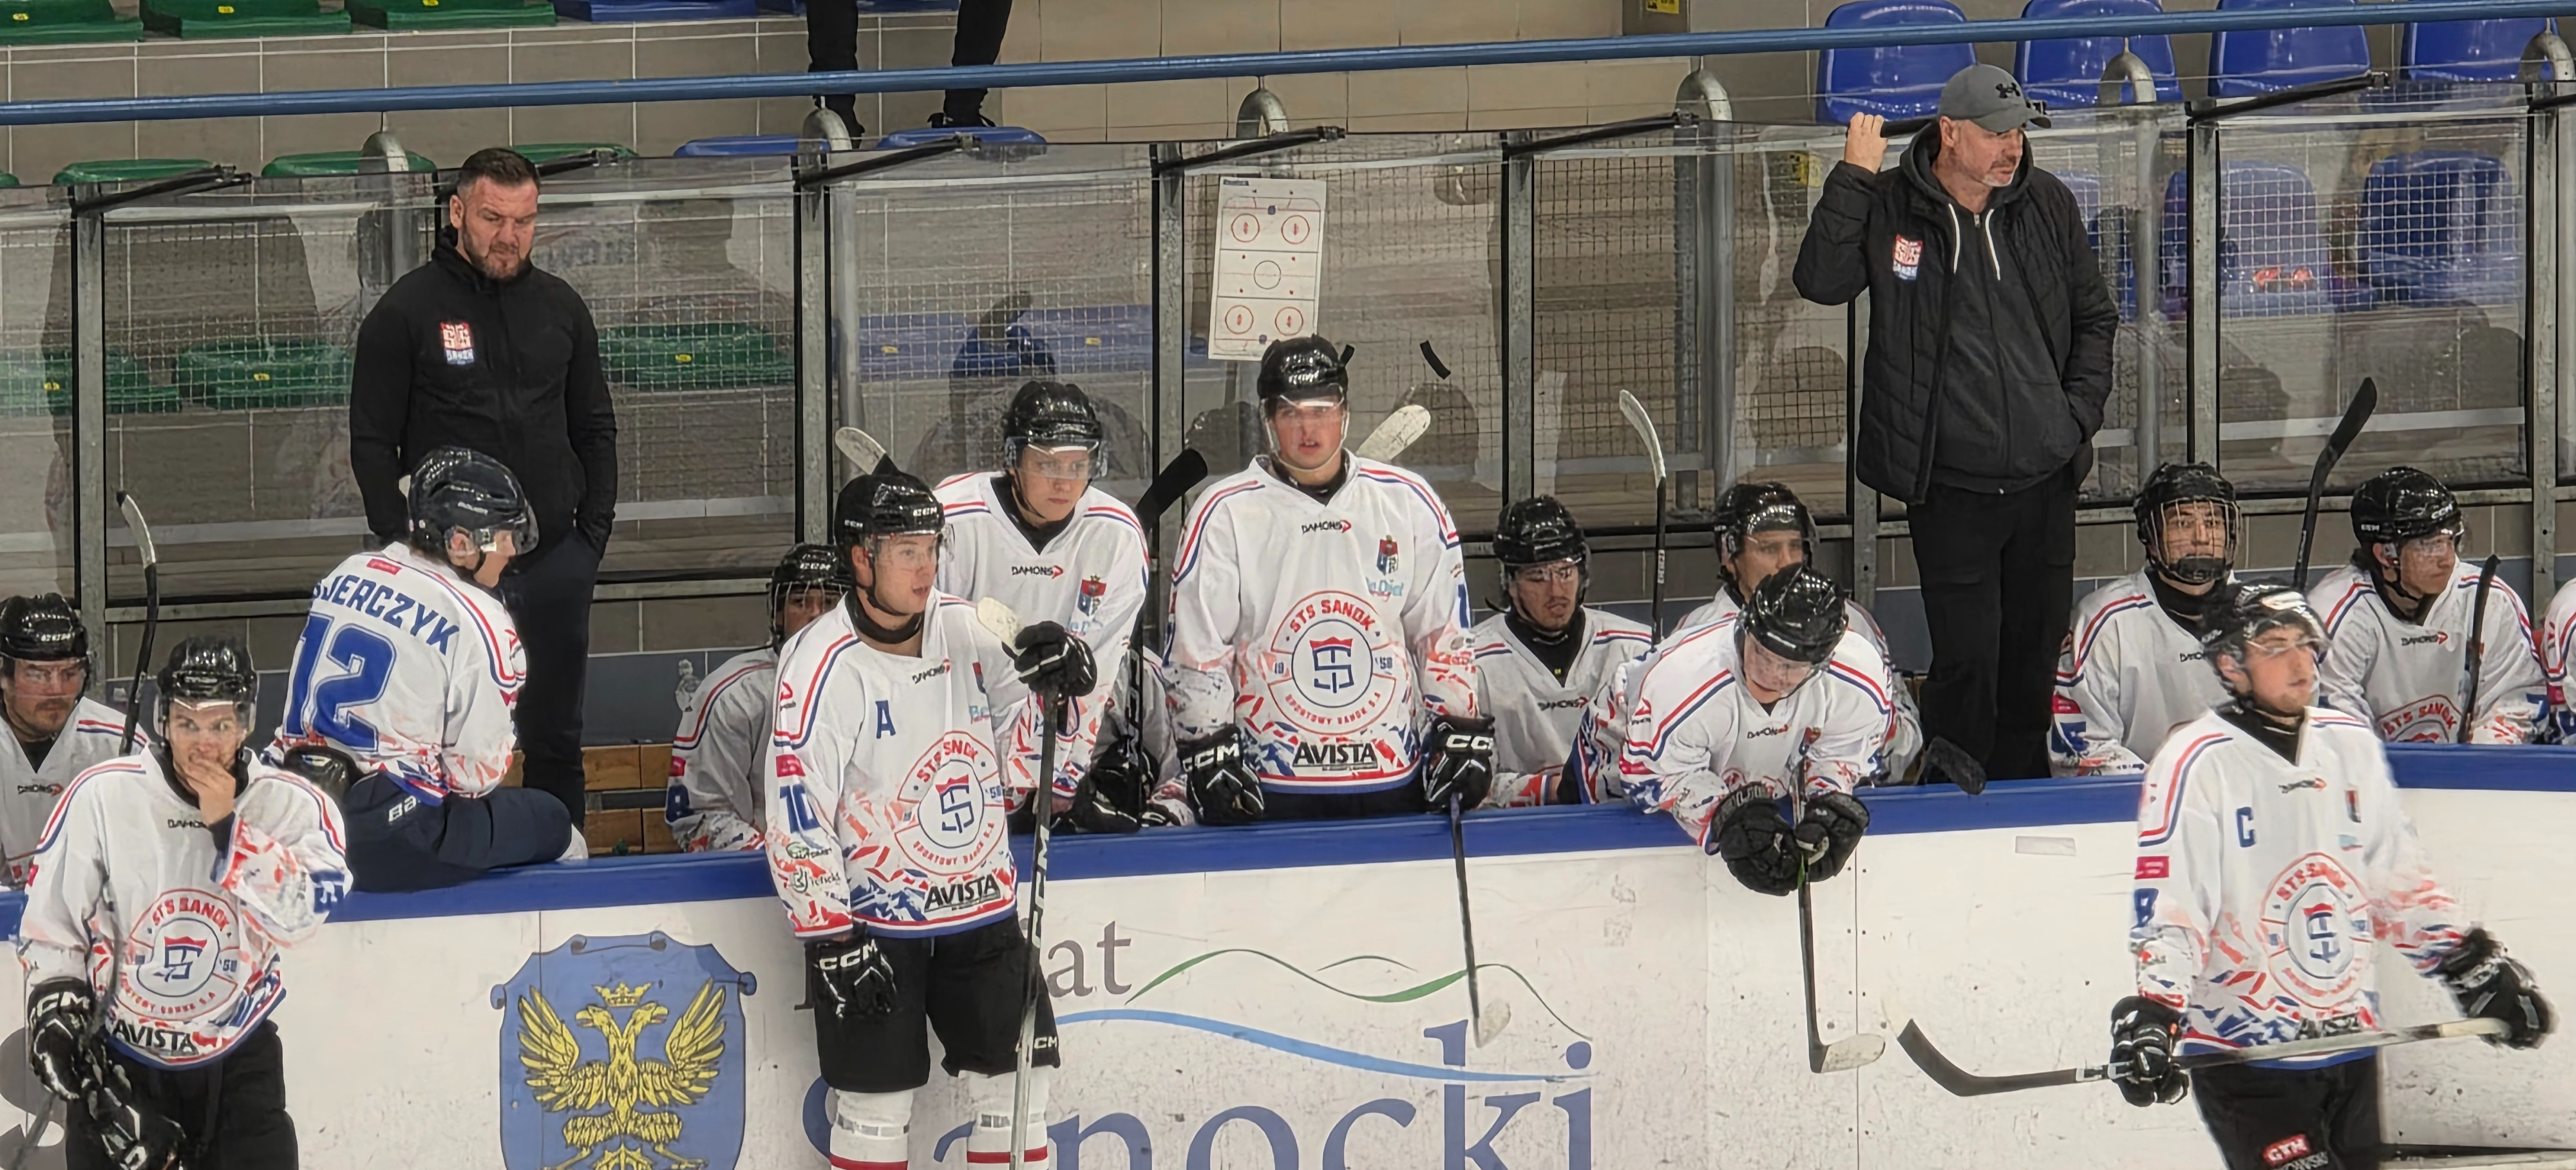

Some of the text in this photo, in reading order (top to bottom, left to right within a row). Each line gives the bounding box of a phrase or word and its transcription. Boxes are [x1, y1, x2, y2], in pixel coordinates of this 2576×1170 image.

[2431, 503, 2453, 519] CCM
[1011, 566, 1054, 577] DAMONS
[312, 574, 460, 656] JERCZYK
[1290, 599, 1376, 633] STS SANOK
[283, 612, 397, 753] 12
[875, 700, 896, 739] A
[1292, 741, 1378, 766] AVISTA
[1446, 734, 1493, 750] CC
[2237, 806, 2256, 848] C
[923, 874, 1000, 912] AVISTA
[819, 939, 878, 970] CCM
[113, 1019, 200, 1056] AVISTA
